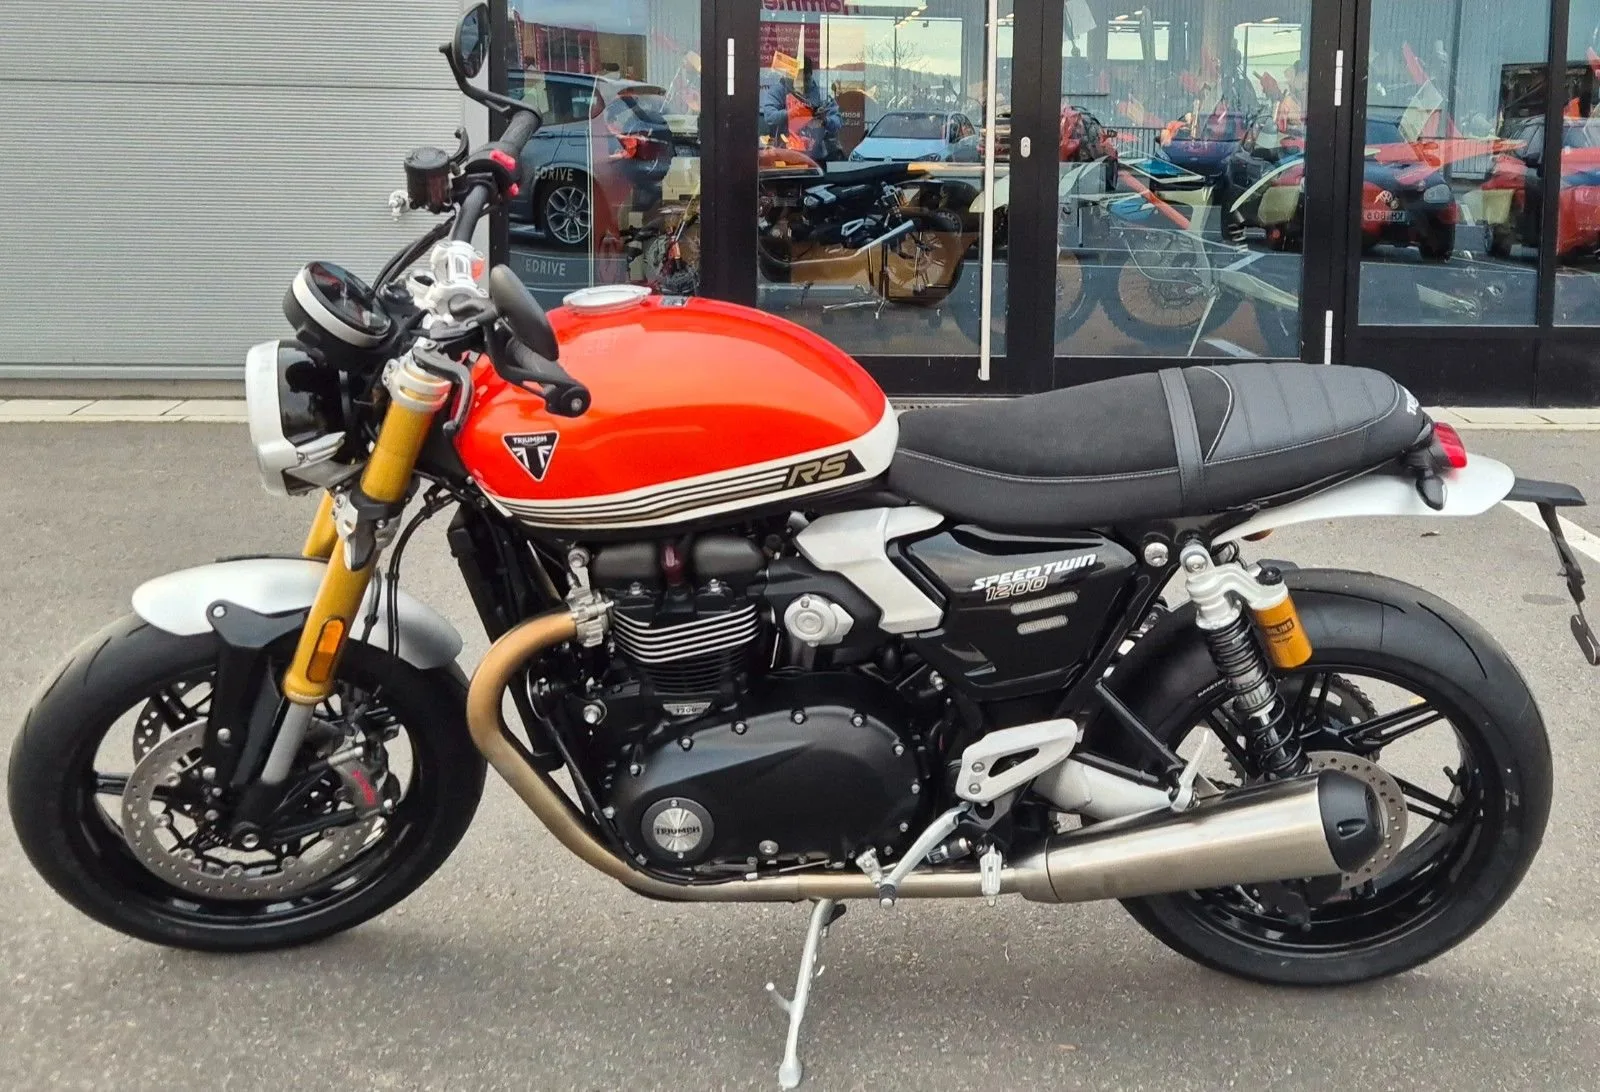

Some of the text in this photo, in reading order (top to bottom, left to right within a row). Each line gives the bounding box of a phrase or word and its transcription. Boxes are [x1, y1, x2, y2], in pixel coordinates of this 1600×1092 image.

[525, 259, 566, 277] EDRIVE
[512, 435, 548, 445] TRIUMPH
[787, 452, 849, 488] RS
[971, 554, 1097, 591] SPEED TWIN
[985, 576, 1048, 602] 1200
[655, 826, 701, 835] TRIUMPH
